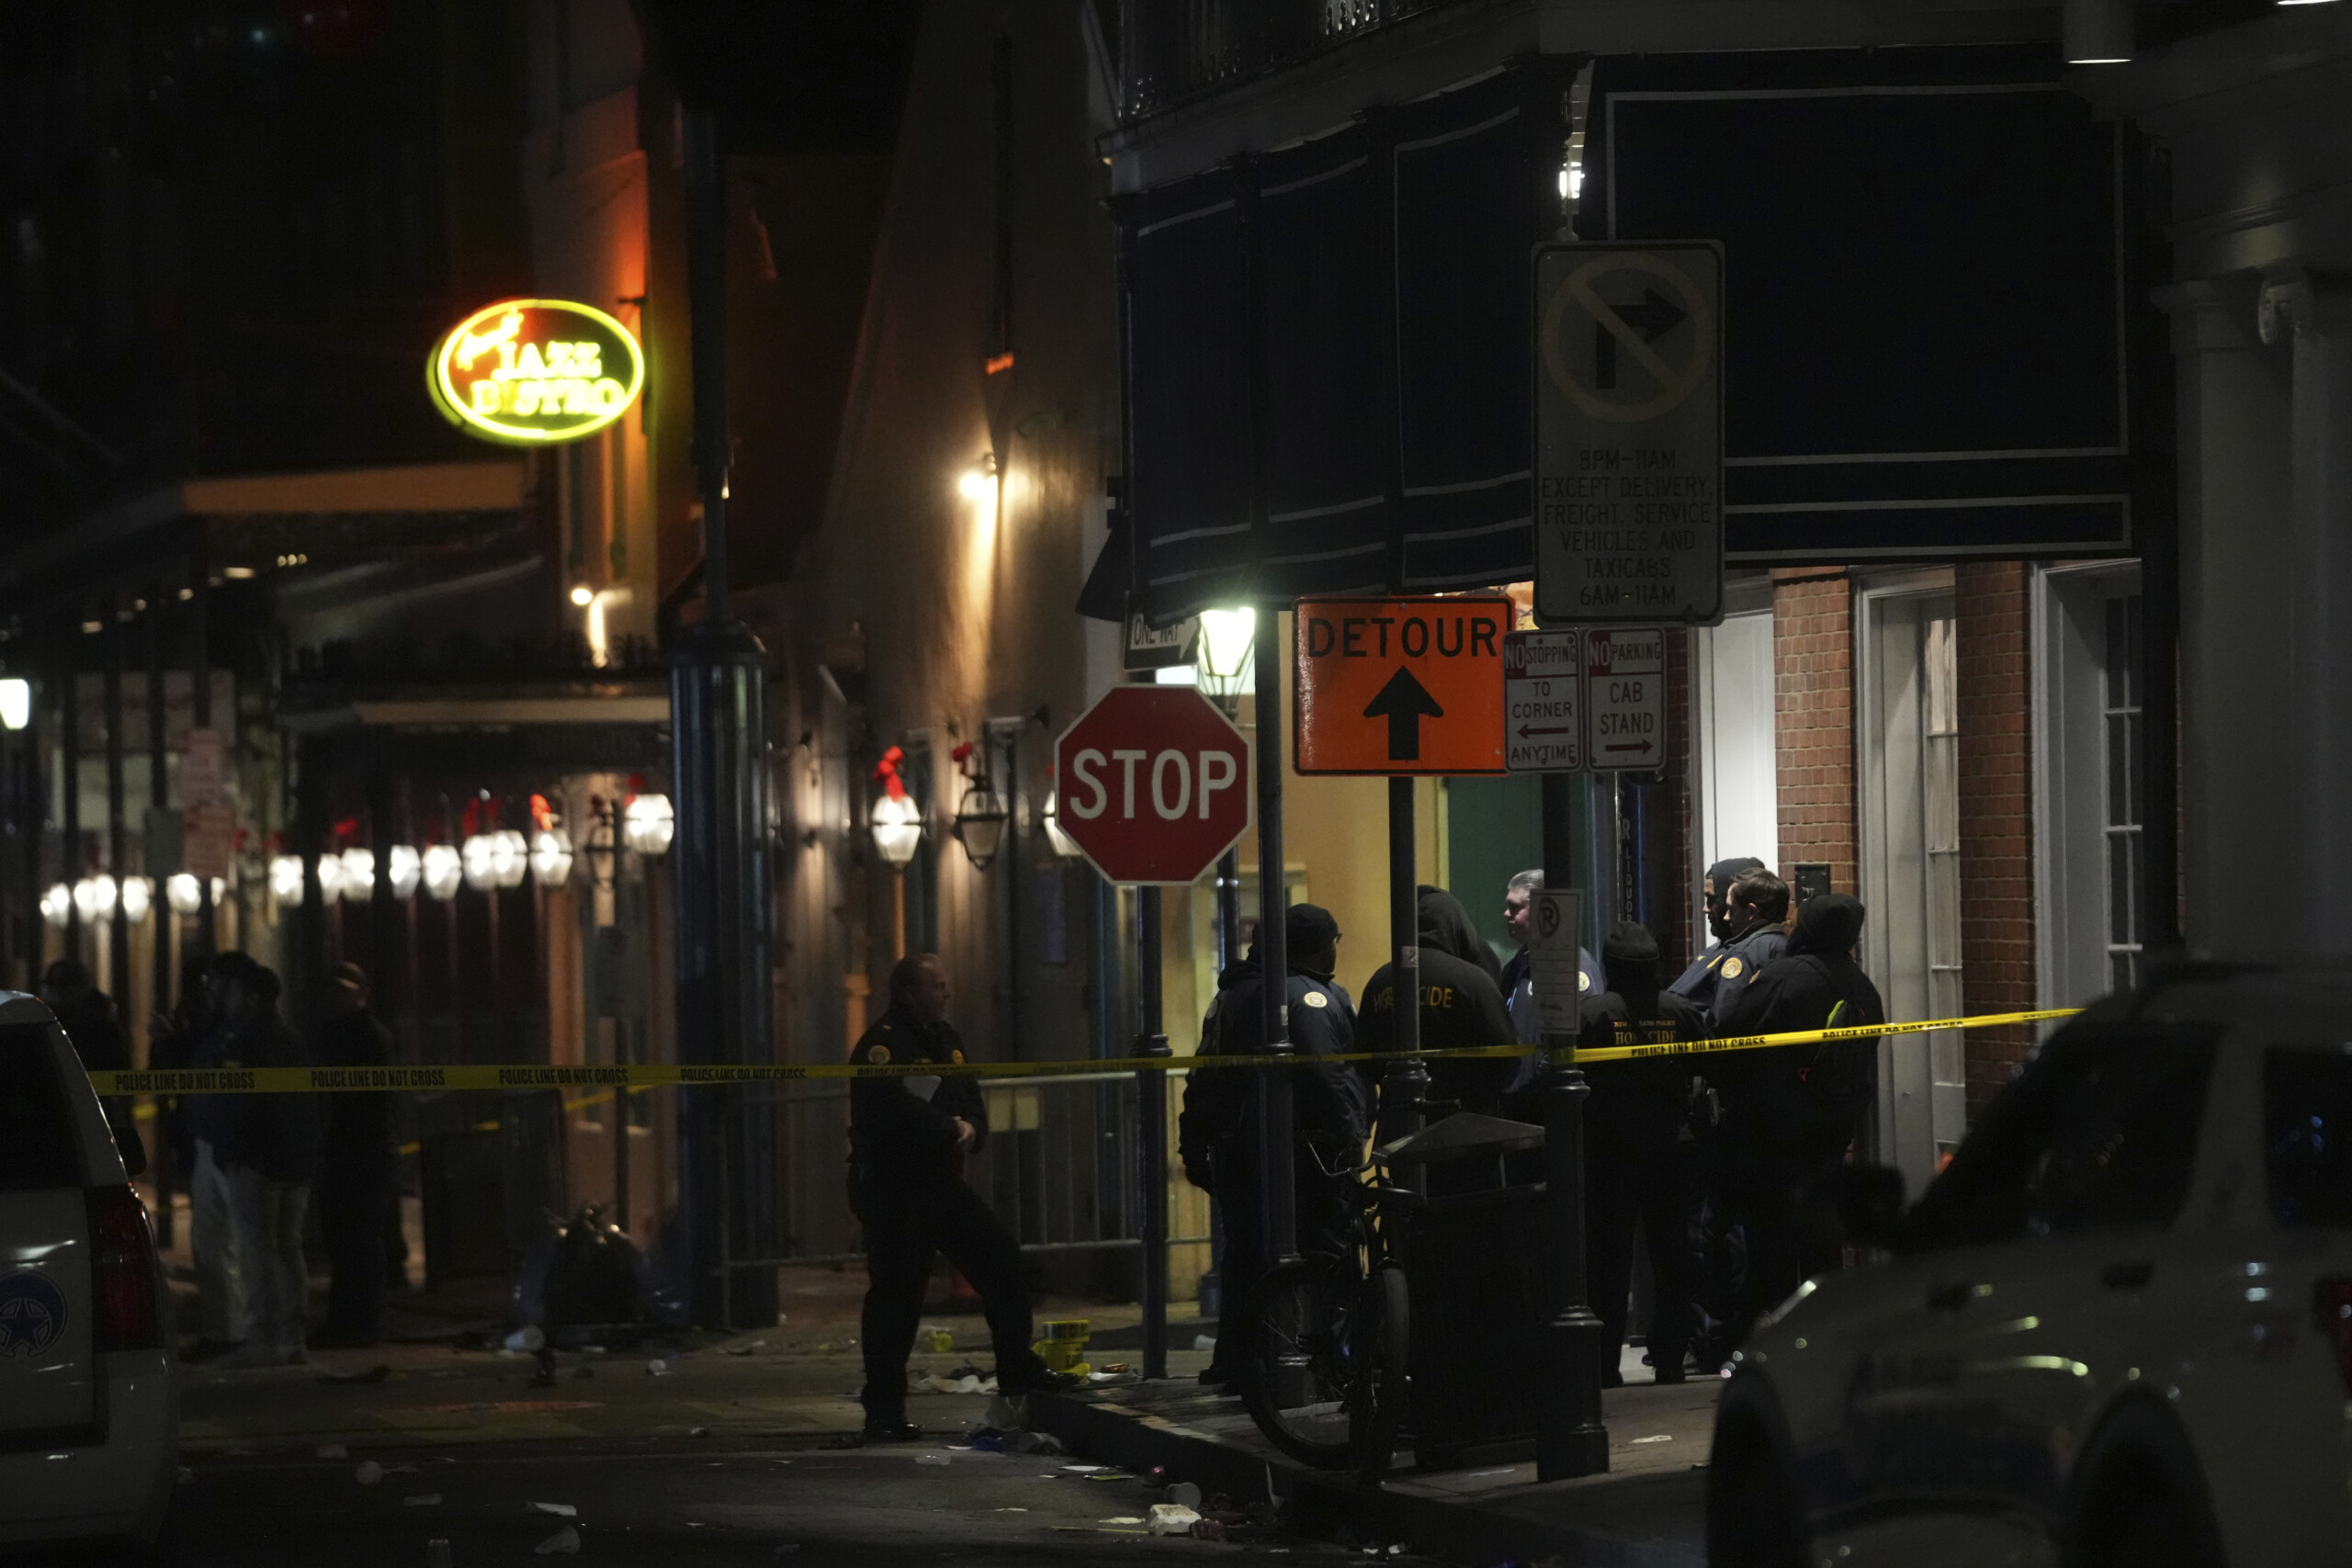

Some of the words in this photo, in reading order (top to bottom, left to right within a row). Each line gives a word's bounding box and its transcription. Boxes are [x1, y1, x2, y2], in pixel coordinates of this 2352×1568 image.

[491, 341, 602, 381] JAZZ
[1542, 477, 1611, 498] EXCEPT
[1634, 504, 1710, 524] SERVICE
[1562, 530, 1647, 551] VEHICLES
[1660, 530, 1695, 550] AND
[1584, 558, 1671, 578] TAXICABS
[1308, 616, 1498, 658] DETOUR
[1505, 643, 1526, 670] NO
[1527, 645, 1577, 664] STOPPING
[1589, 640, 1609, 666] NO
[1611, 642, 1661, 661] PARKING
[1532, 682, 1551, 696] TO
[1610, 682, 1643, 704] CAB
[1512, 702, 1573, 718] CORNER
[1600, 712, 1654, 735] STAND
[1511, 745, 1577, 761] ANYTIME
[1069, 748, 1238, 820] STOP
[116, 1074, 152, 1090] POLICE
[154, 1073, 176, 1090] LINE
[179, 1073, 193, 1089] DO
[197, 1073, 216, 1089] NOT
[220, 1072, 255, 1089] CROSS
[311, 1071, 346, 1088] POLICE
[349, 1070, 370, 1087] LINE
[372, 1070, 386, 1087] DO
[389, 1070, 408, 1086] NOT
[411, 1069, 446, 1086] CROSS
[499, 1069, 534, 1085] POLICE
[536, 1069, 557, 1084] LINE
[559, 1069, 571, 1084] DO
[573, 1068, 594, 1084] NOT
[595, 1068, 628, 1084] CROSS
[681, 1068, 713, 1080] POLICE
